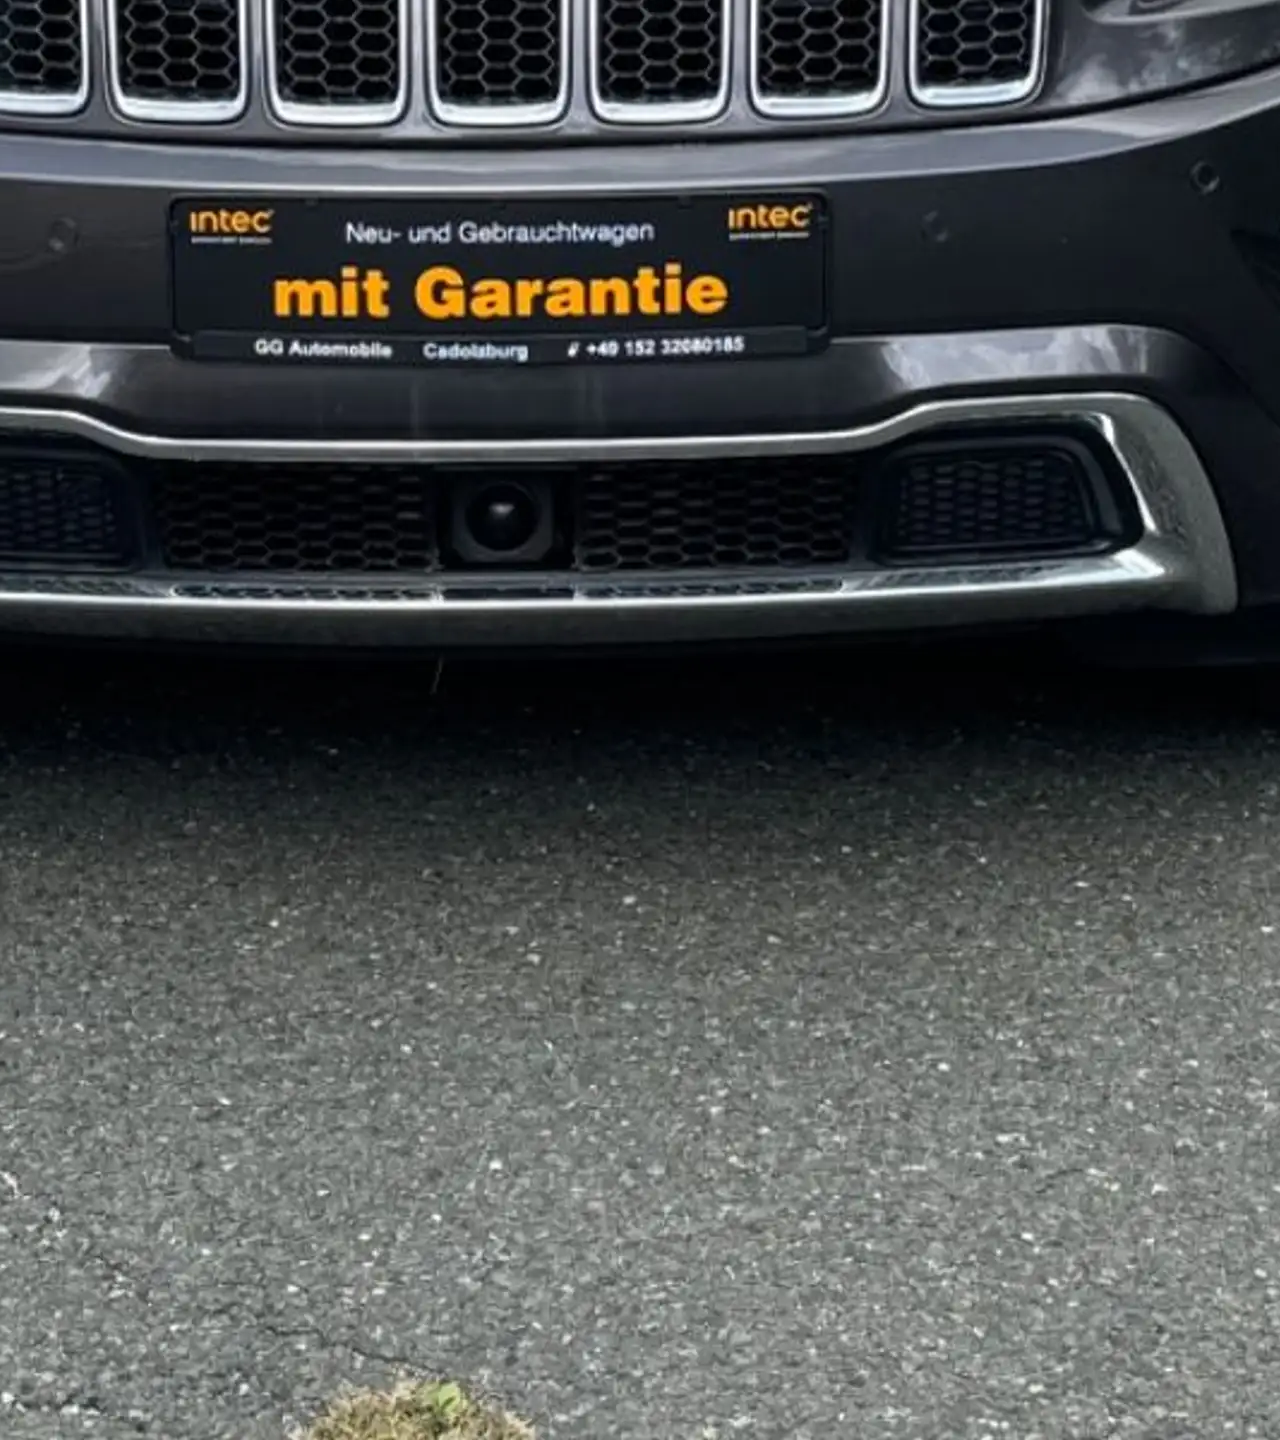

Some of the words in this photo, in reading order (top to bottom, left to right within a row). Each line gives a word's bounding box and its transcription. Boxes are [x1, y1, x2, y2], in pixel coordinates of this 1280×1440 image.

[190, 209, 272, 234] intec
[728, 203, 811, 229] intec
[345, 222, 402, 244] Neu-
[408, 222, 453, 243] und
[458, 220, 655, 247] Gebrauchtwagen
[274, 265, 390, 318] mit
[415, 262, 729, 320] Garantie
[254, 339, 284, 355] GG
[288, 340, 393, 358] Automobile
